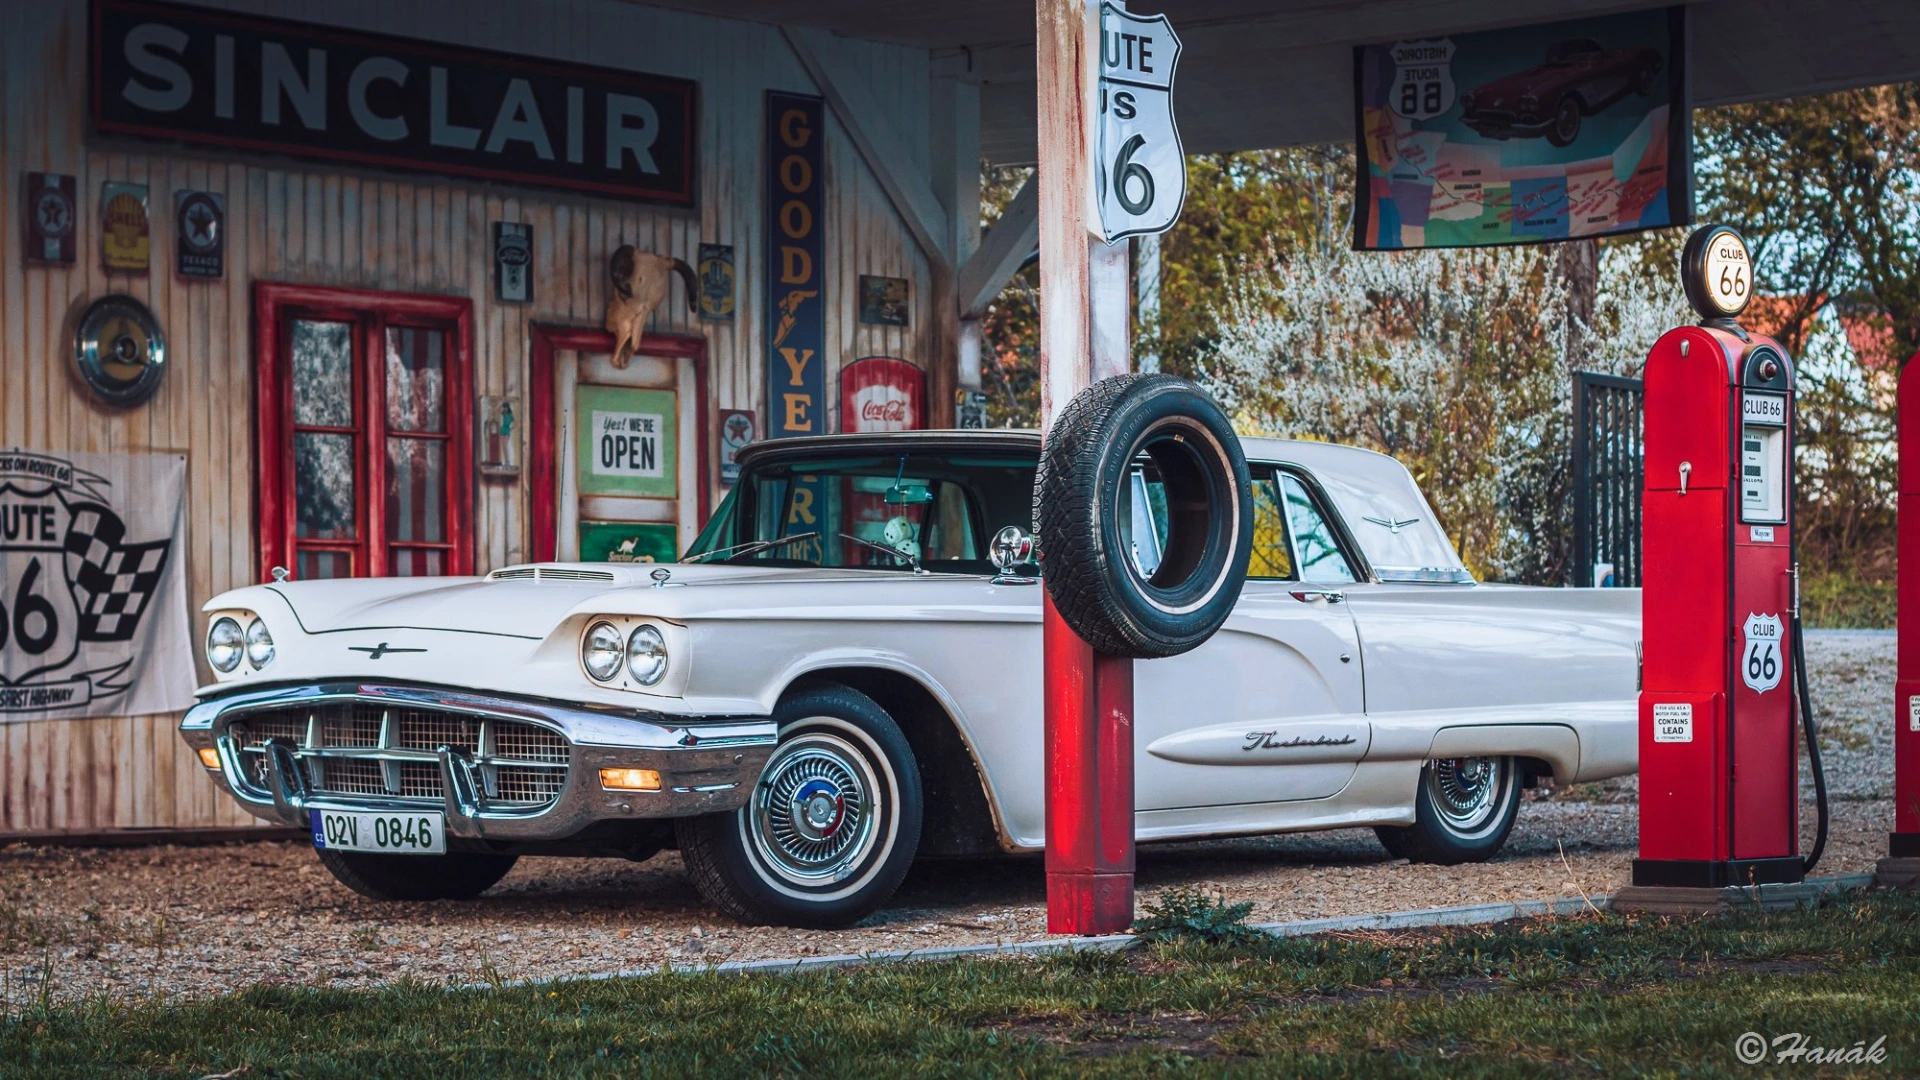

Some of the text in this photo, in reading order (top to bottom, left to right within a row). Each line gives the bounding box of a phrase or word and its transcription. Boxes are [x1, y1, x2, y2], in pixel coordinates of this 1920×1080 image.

[121, 22, 661, 175] SINCLAIR
[1101, 133, 1155, 216] 6
[183, 255, 219, 266] TEXACO
[1720, 248, 1744, 262] CLUB
[1720, 265, 1746, 297] 66
[1744, 400, 1780, 416] CLUB 66
[603, 415, 655, 433] Yes! WE'RE
[601, 434, 655, 470] OPEN
[14, 458, 27, 471] ON
[28, 459, 55, 478] ROUTE
[57, 468, 70, 481] 66
[0, 504, 57, 541] UTE
[0, 556, 58, 655] 6
[1752, 623, 1776, 636] CLUB
[1749, 643, 1776, 680] 66
[29, 688, 74, 706] HIGHWAY
[1242, 730, 1357, 751] Thunderbird
[1662, 727, 1684, 735] LEAD
[315, 833, 324, 843] CZ
[325, 814, 432, 848] 02V 0846
